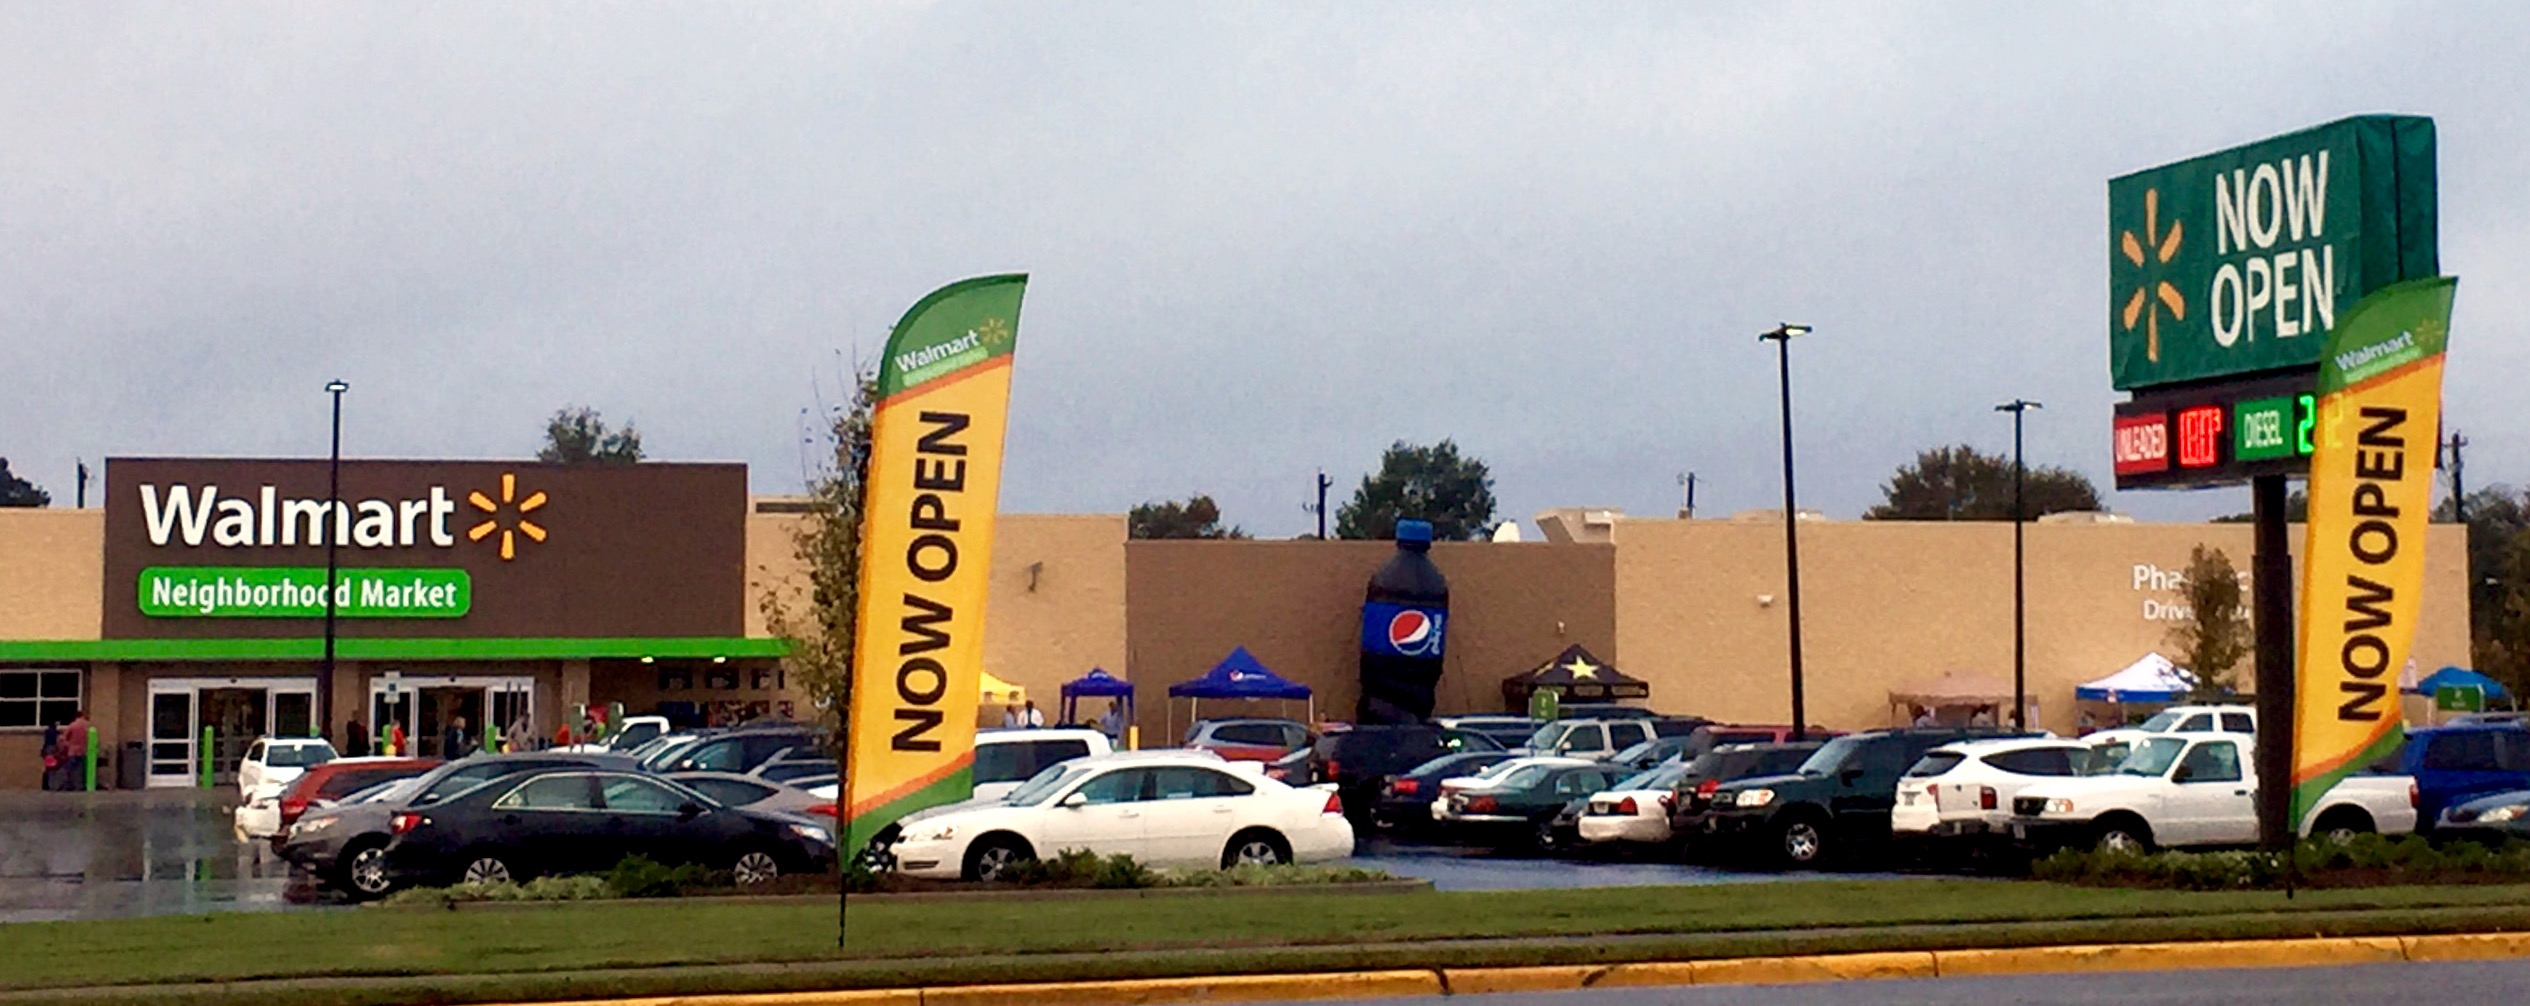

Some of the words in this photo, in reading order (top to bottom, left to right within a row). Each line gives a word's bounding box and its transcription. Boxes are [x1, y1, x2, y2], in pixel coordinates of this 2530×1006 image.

[2215, 149, 2330, 255] NOW
[2210, 244, 2335, 348] OPEN
[894, 328, 981, 373] Walmart
[2334, 330, 2415, 371] Walmart
[2243, 409, 2284, 449] DIESEL
[138, 484, 455, 548] Walmart
[906, 410, 971, 583] OPEN
[2349, 406, 2407, 565] OPEN
[360, 578, 457, 608] Market
[891, 592, 954, 752] NOW
[2337, 574, 2394, 722] NOW
